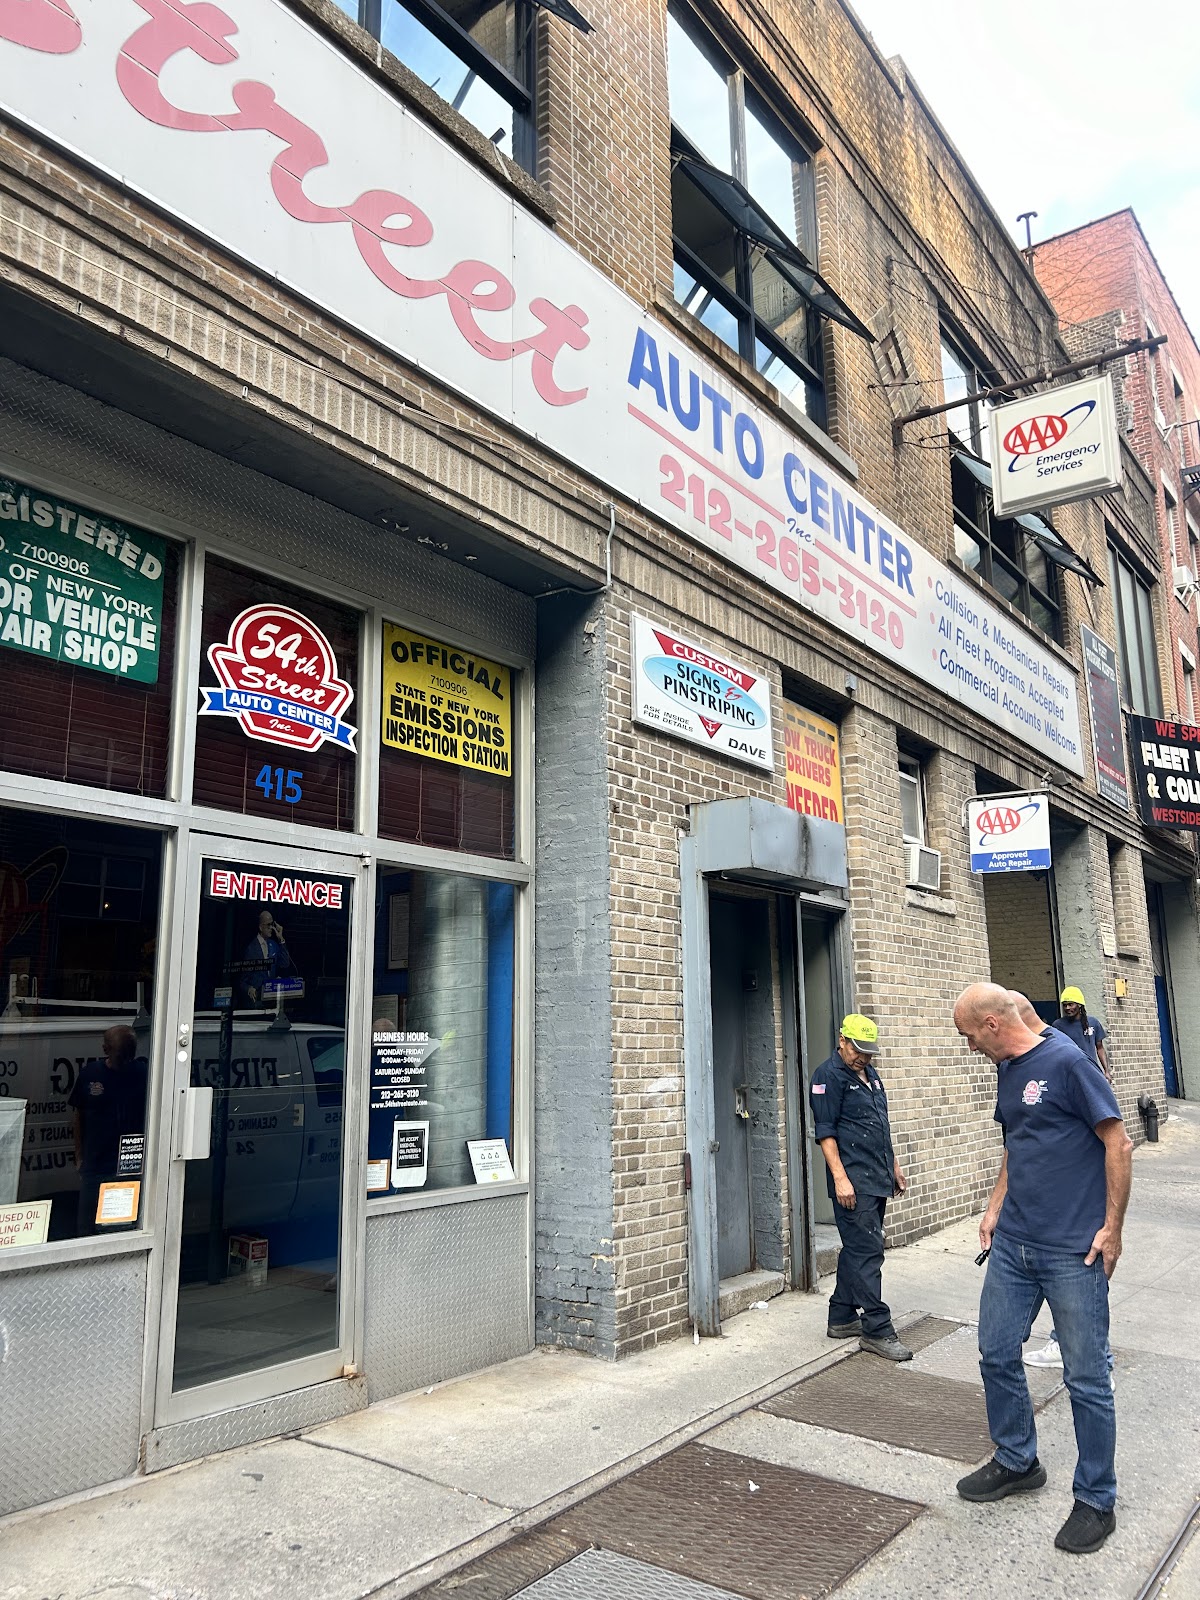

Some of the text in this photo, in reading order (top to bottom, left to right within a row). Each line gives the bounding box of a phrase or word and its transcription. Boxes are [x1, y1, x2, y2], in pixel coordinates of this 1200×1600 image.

[1009, 415, 1064, 454] AAA
[627, 326, 916, 598] AUTO CENTER
[1036, 443, 1101, 466] Emergency
[1036, 459, 1084, 478] Services
[786, 517, 816, 546] Inc.
[21, 541, 90, 575] 7100906
[659, 454, 904, 650] 212-265-3120
[9, 563, 154, 621] OF NEW YORK
[45, 592, 157, 651] VEHICLE
[63, 630, 138, 673] SHOP
[935, 580, 1069, 700] Collision & Mechanical Repairs
[391, 641, 504, 701] OFFICIAL
[672, 643, 743, 685] CUSTOM
[938, 616, 952, 641] All
[956, 628, 981, 662] Fleet
[984, 650, 1025, 694] Programs
[1028, 683, 1064, 722] Accepted
[239, 665, 327, 705] Street
[430, 674, 468, 696] 7100906
[677, 663, 743, 701] SIGNS &
[229, 692, 333, 731] AUTO CENTER
[395, 682, 500, 725] STATE OF NEW YORK
[643, 704, 690, 724] ASK INSIDE
[663, 675, 756, 726] PINSTRIPING
[939, 649, 1076, 755] Commercial Accounts Welcome
[269, 719, 295, 733] Inc.
[390, 694, 505, 748] EMISSIONS
[643, 709, 694, 733] FOR DETAILS
[1155, 720, 1176, 738] WE
[386, 718, 509, 772] INSPECTION STATION
[728, 737, 767, 760] DAVE
[804, 736, 836, 768] TRUCK
[1140, 741, 1190, 773] FLEET
[255, 764, 303, 804] 415
[787, 751, 831, 787] DRIVERS
[1147, 773, 1162, 799] &
[980, 807, 1018, 834] AAA
[989, 859, 1032, 868] Auto Repair
[992, 851, 1028, 861] Approved
[210, 869, 343, 909] ENTRANCE
[373, 1031, 429, 1042] BUSINESS HOURS
[377, 1048, 425, 1056] MONDAY-FRIDAY
[374, 1067, 426, 1076] SATURDAY-SUNDAY
[390, 1076, 411, 1084] CLOSED
[380, 1088, 420, 1099] 212-265-3120
[23, 1222, 35, 1231] AT
[26, 1210, 40, 1220] OIL
